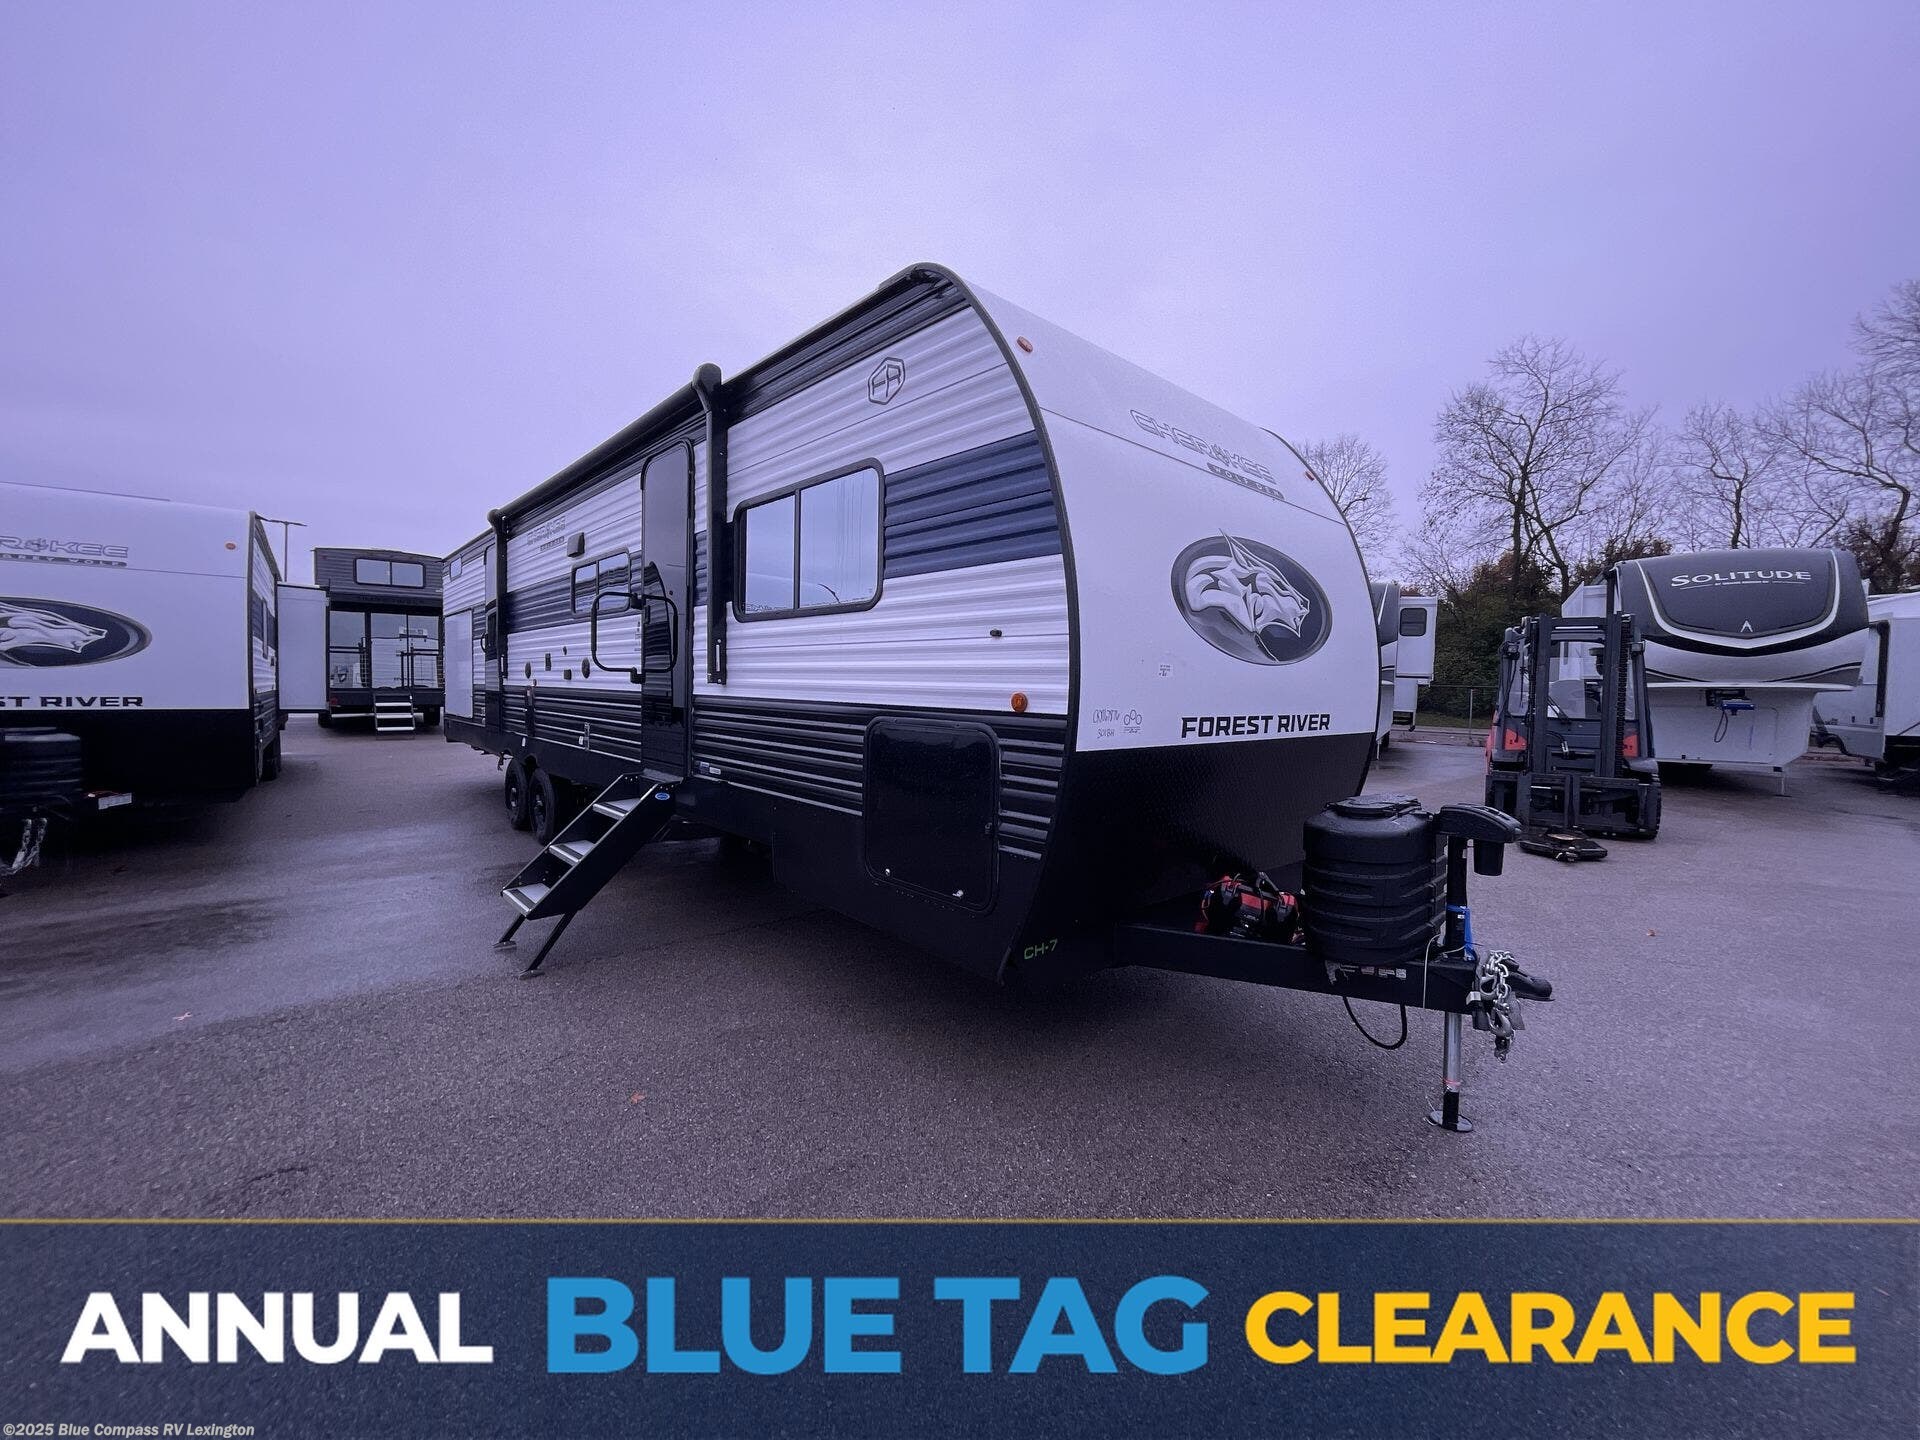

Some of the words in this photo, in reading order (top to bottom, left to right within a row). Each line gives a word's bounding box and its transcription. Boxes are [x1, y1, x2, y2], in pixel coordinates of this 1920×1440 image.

[1130, 409, 1277, 485] CHEROKEE
[1671, 570, 1812, 587] SOLITUDE
[40, 696, 143, 707] RIVER
[1181, 715, 1274, 738] FOREST
[1277, 713, 1331, 733] RIVER
